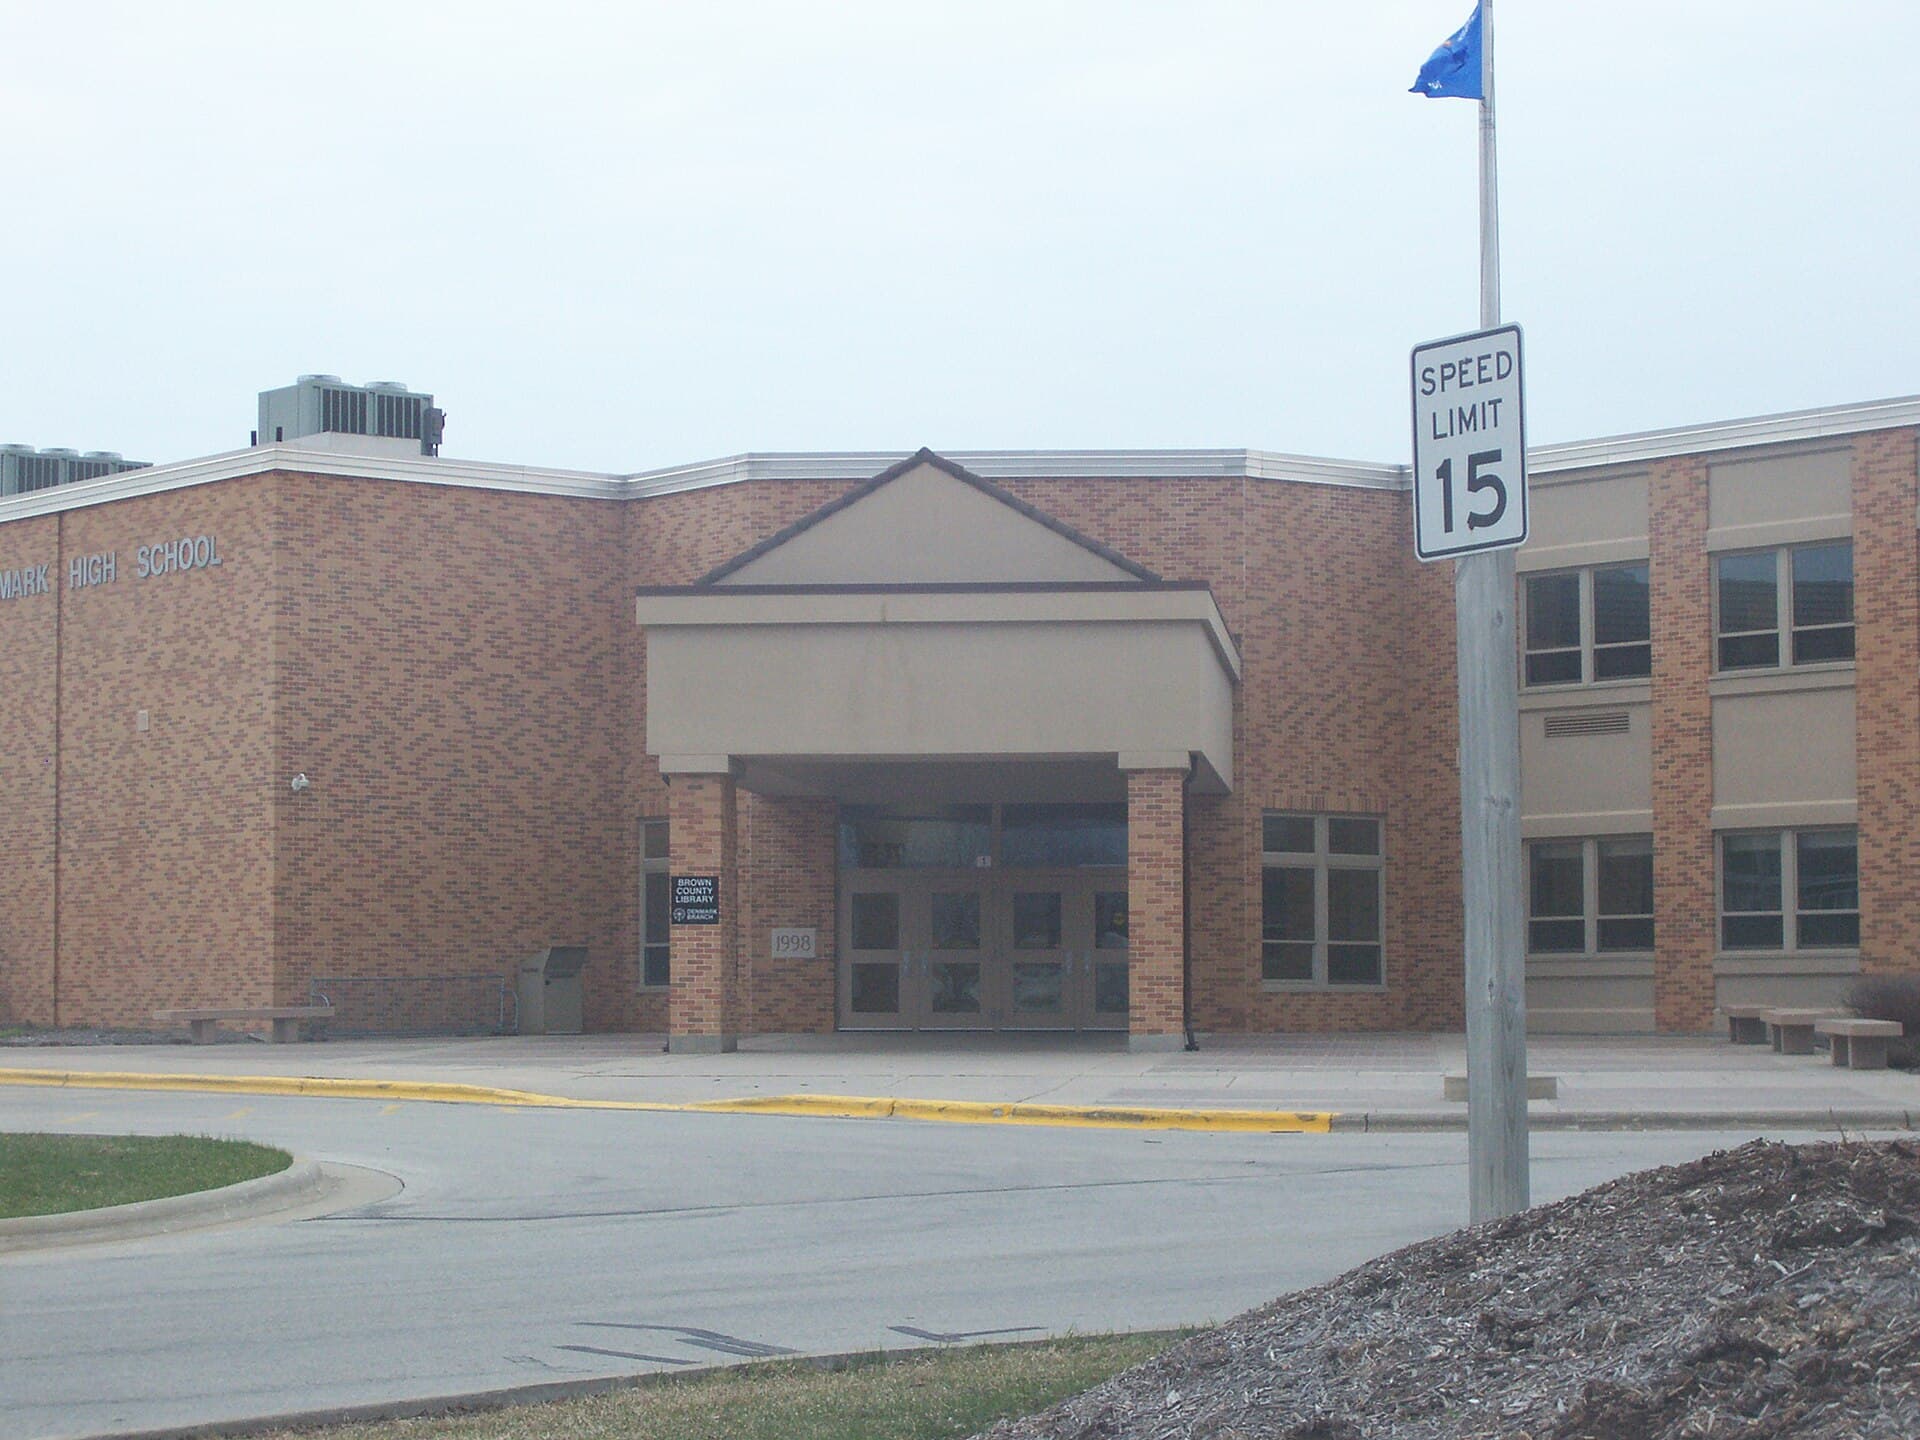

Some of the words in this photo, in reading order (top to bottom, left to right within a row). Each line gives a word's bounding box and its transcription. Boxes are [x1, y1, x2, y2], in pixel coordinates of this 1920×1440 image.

[1420, 351, 1513, 396] SPEED
[1432, 398, 1503, 440] LIMIT
[1435, 448, 1507, 533] 15
[0, 564, 49, 599] MARK
[69, 552, 117, 589] HIGH
[137, 535, 223, 578] SCHOOL
[676, 887, 713, 895] COUNTY
[678, 878, 712, 887] BROWN
[675, 895, 714, 904] LIBRARY
[775, 934, 812, 952] 1998
